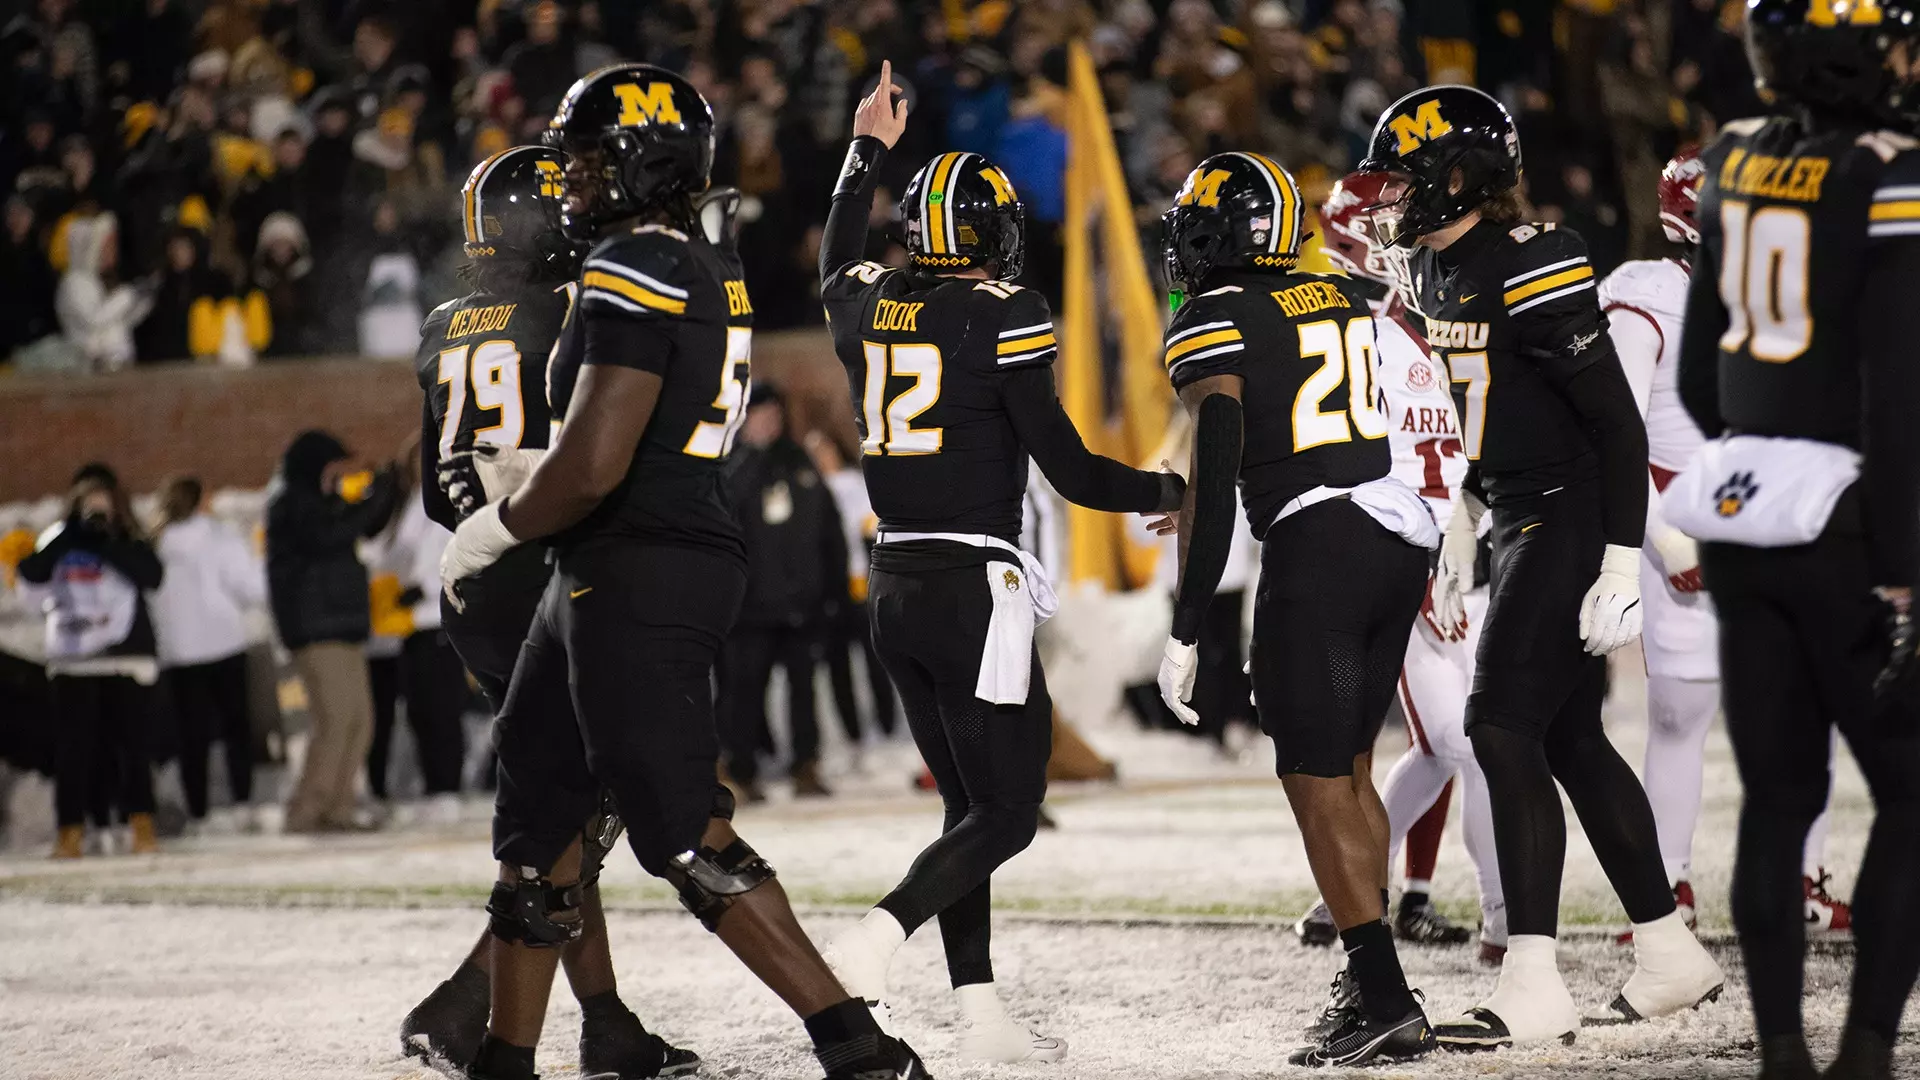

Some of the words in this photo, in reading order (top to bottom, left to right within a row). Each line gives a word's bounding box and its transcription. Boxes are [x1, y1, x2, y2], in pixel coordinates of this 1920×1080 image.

[613, 81, 682, 127] M
[1388, 98, 1452, 157] M
[978, 166, 1018, 207] M
[1180, 167, 1232, 207] M
[1271, 281, 1351, 317] ROBERTS
[1718, 200, 1815, 364] 10
[447, 304, 517, 339] MEMBOU
[873, 299, 924, 332] COOK
[1426, 318, 1490, 349] ZZOU
[437, 339, 525, 461] 79
[682, 325, 752, 459] 5
[862, 340, 943, 457] 12
[1292, 316, 1389, 453] 20
[1401, 407, 1457, 434] ARK
